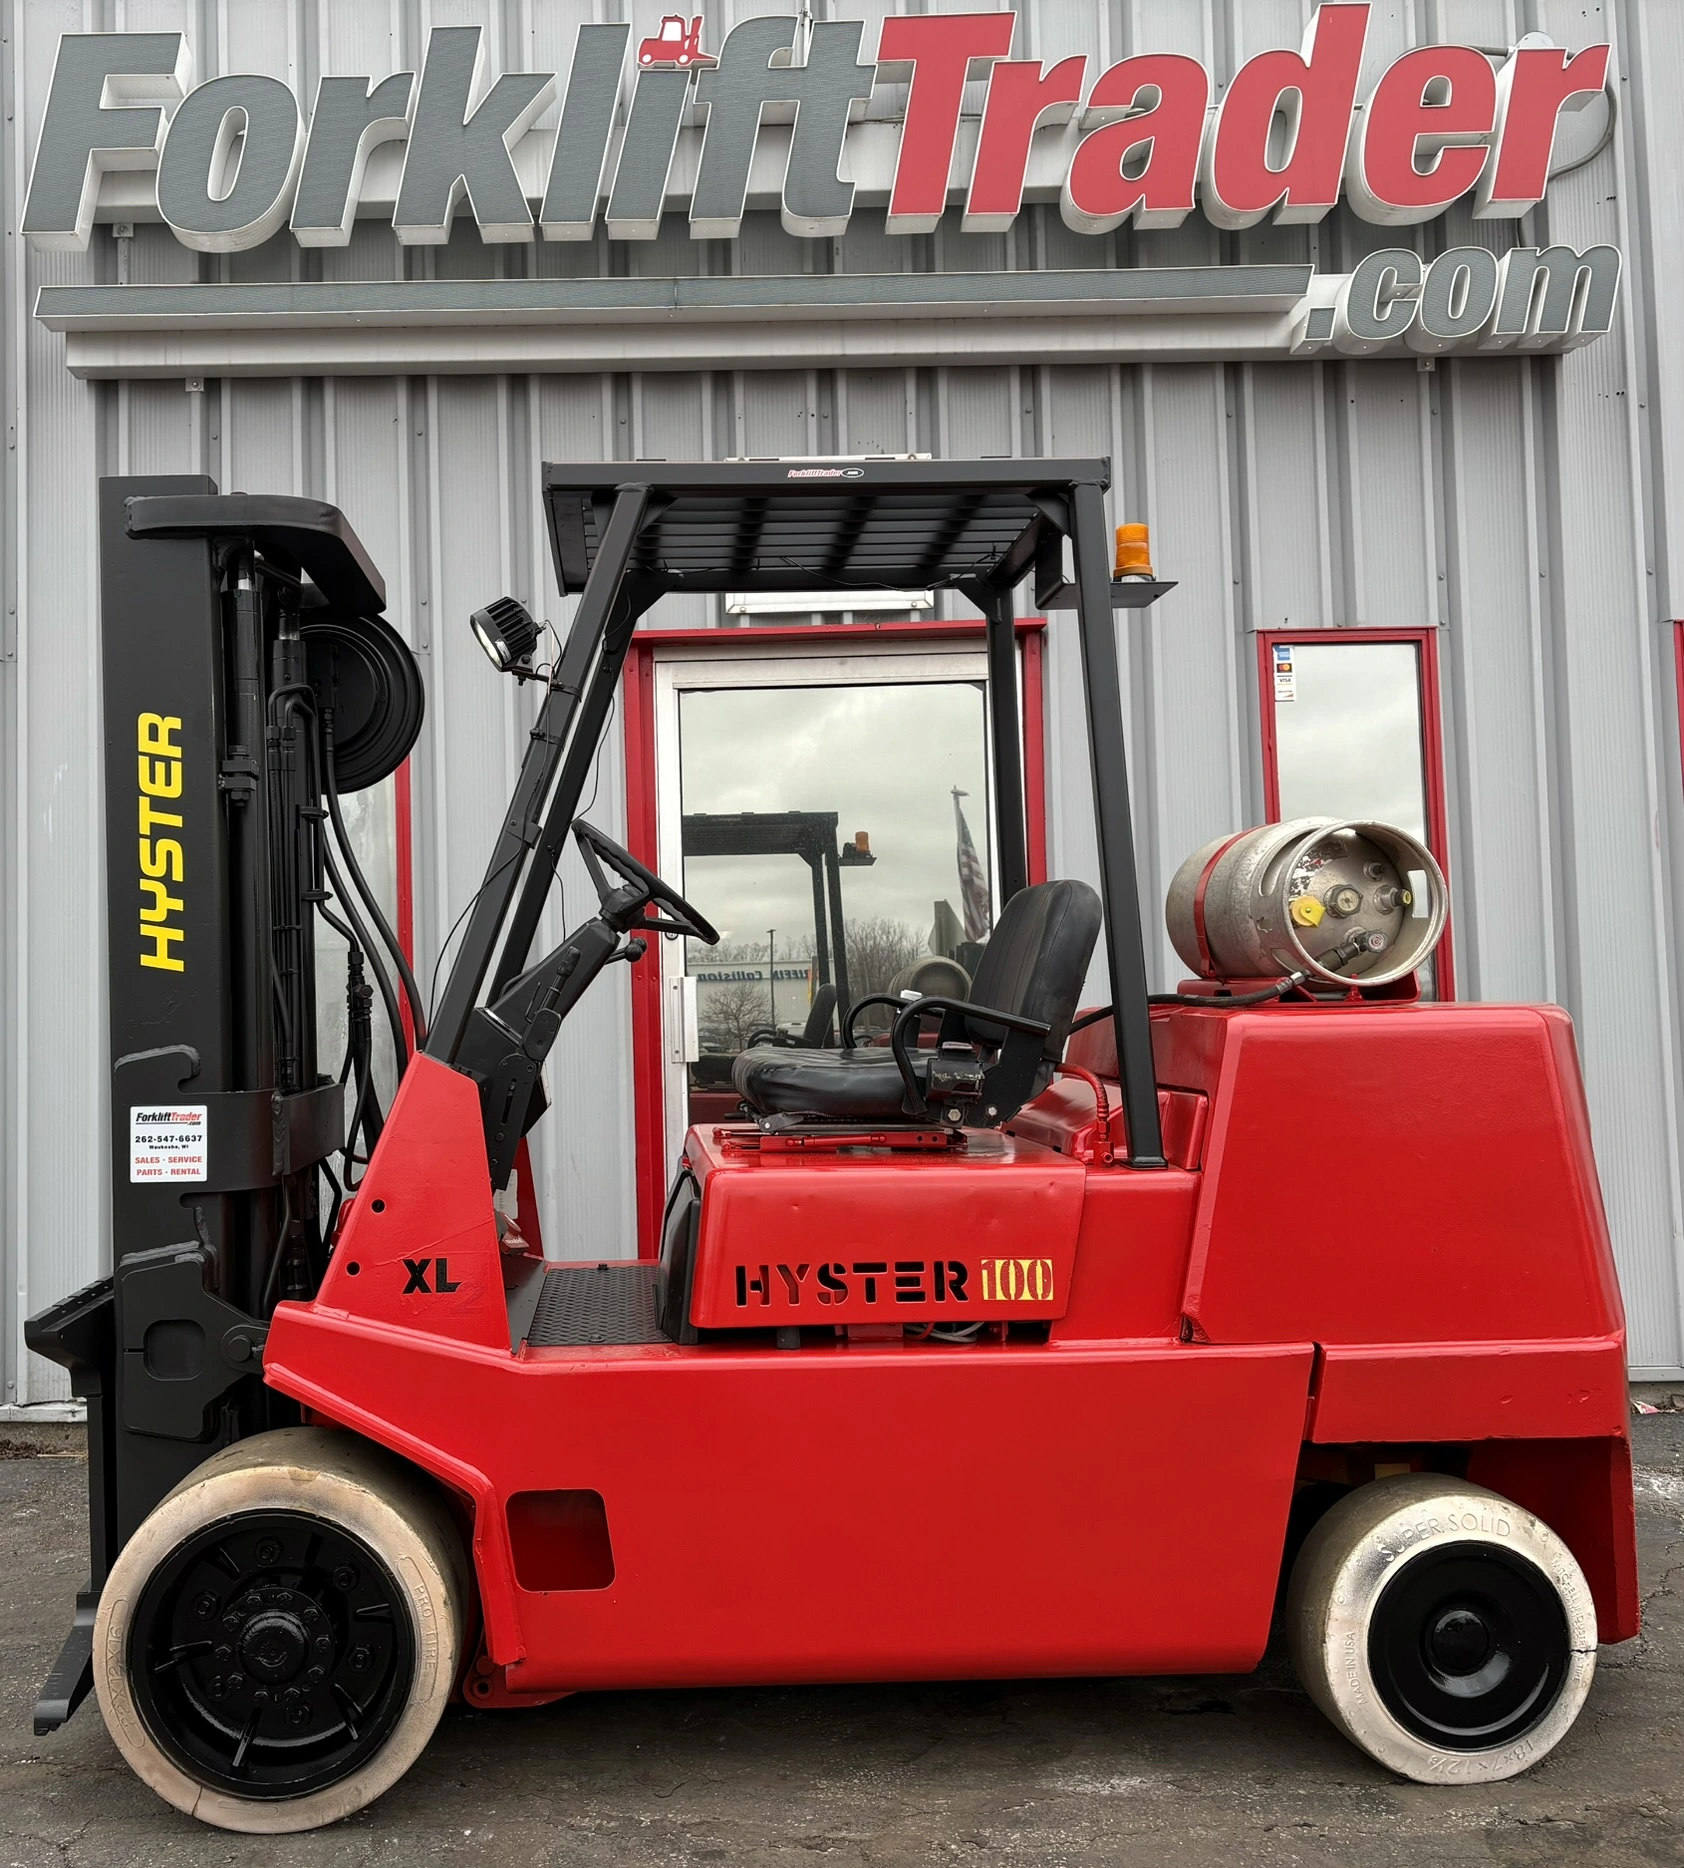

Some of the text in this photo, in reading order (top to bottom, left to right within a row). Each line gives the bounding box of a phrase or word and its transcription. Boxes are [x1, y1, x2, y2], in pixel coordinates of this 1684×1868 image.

[22, 2, 1612, 240] ForkliftTrader
[1304, 243, 1623, 343] .com
[137, 712, 185, 973] HYSTER
[135, 1111, 203, 1122] ForkliftTrader
[134, 1134, 203, 1143] 262-547-6637
[135, 1155, 203, 1164] SALES SERVICE
[136, 1168, 163, 1176] PARTS
[402, 1257, 463, 1295] XL
[735, 1257, 1055, 1307] HYSTER 100
[1447, 1512, 1511, 1537] SOLID
[413, 1584, 437, 1671] PRO TIRE
